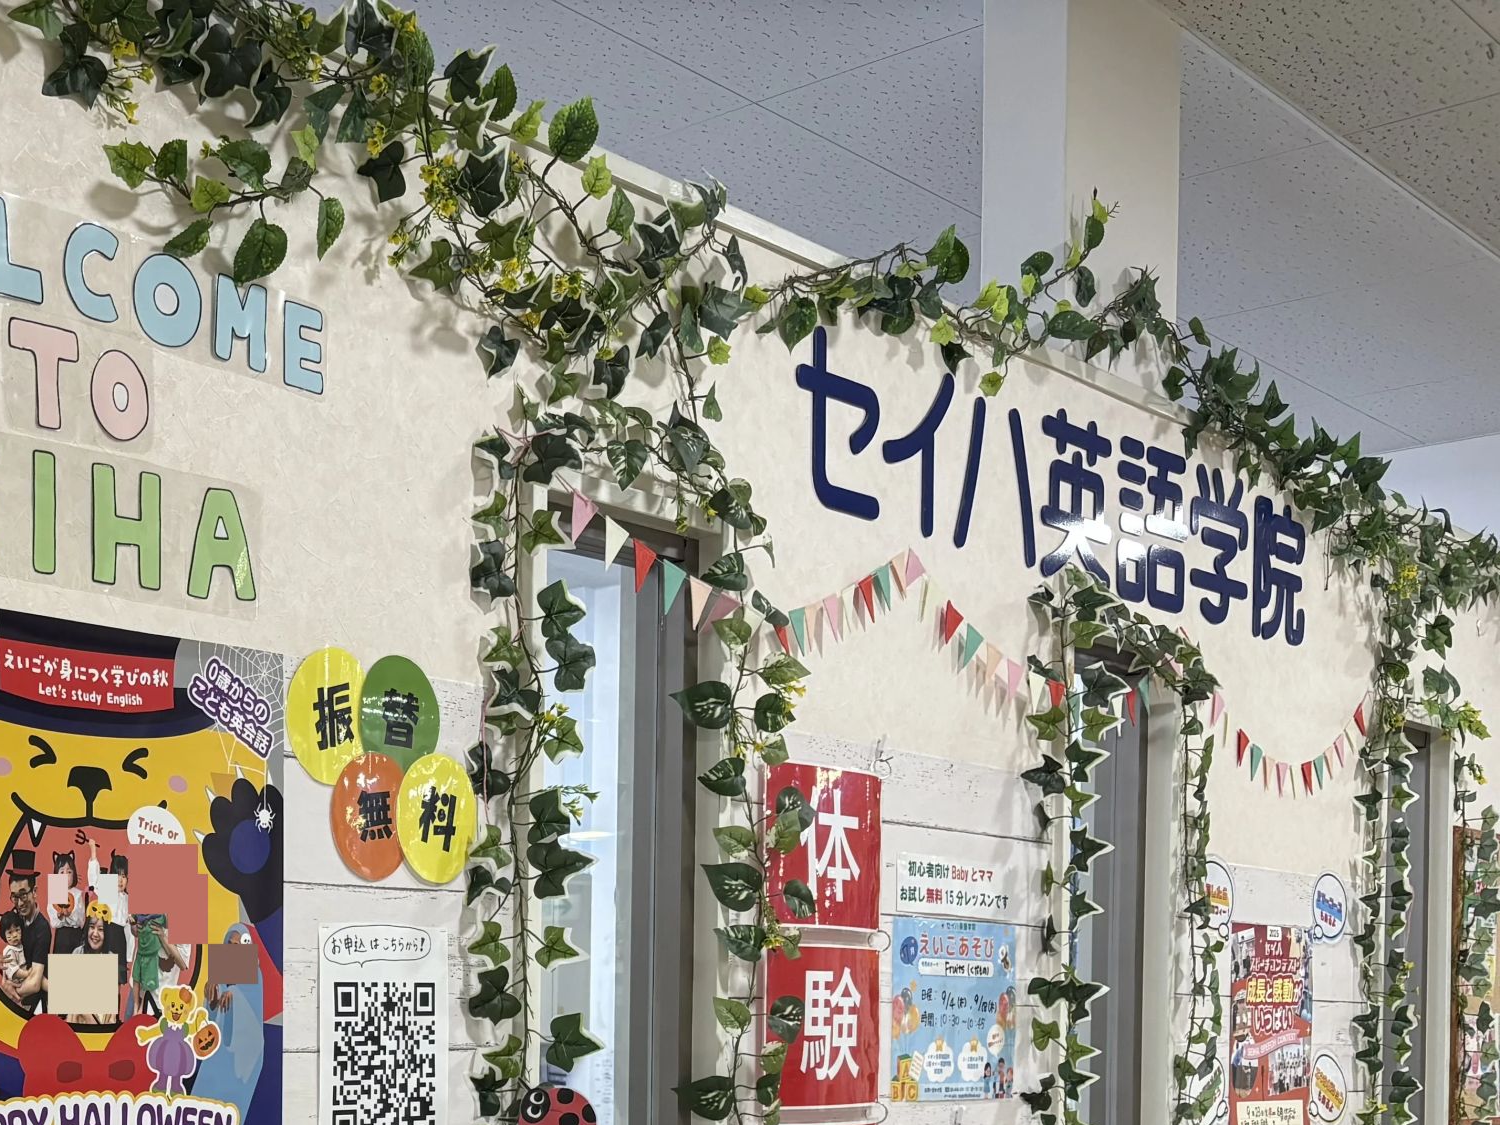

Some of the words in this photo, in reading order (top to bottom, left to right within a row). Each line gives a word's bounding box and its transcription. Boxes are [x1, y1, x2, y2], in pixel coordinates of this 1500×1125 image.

[8, 316, 150, 441] TO
[796, 326, 1306, 646] セイハ英語学院
[3, 648, 169, 688] えいごが身につく学びの秋
[37, 682, 66, 699] Let's
[70, 685, 103, 705] study
[106, 690, 143, 706] English
[206, 661, 271, 724] 0歳からの
[190, 679, 272, 757] こども英会話
[313, 682, 420, 751] 振替
[137, 815, 164, 836] Trick
[166, 827, 179, 841] or
[357, 785, 457, 853] 無料
[908, 860, 949, 879] 初心者向け
[951, 865, 968, 882] Baby
[971, 867, 993, 882] とママ
[900, 885, 943, 905] お試し無料
[945, 889, 954, 904] 15
[956, 890, 1009, 910] 分レッスンです
[1264, 941, 1283, 957] セイハ
[945, 961, 965, 976] Fruits
[1249, 956, 1301, 973] スピーチコンテスト
[1246, 976, 1303, 1004] 成長と感動が
[1253, 1006, 1294, 1032] いっぱい
